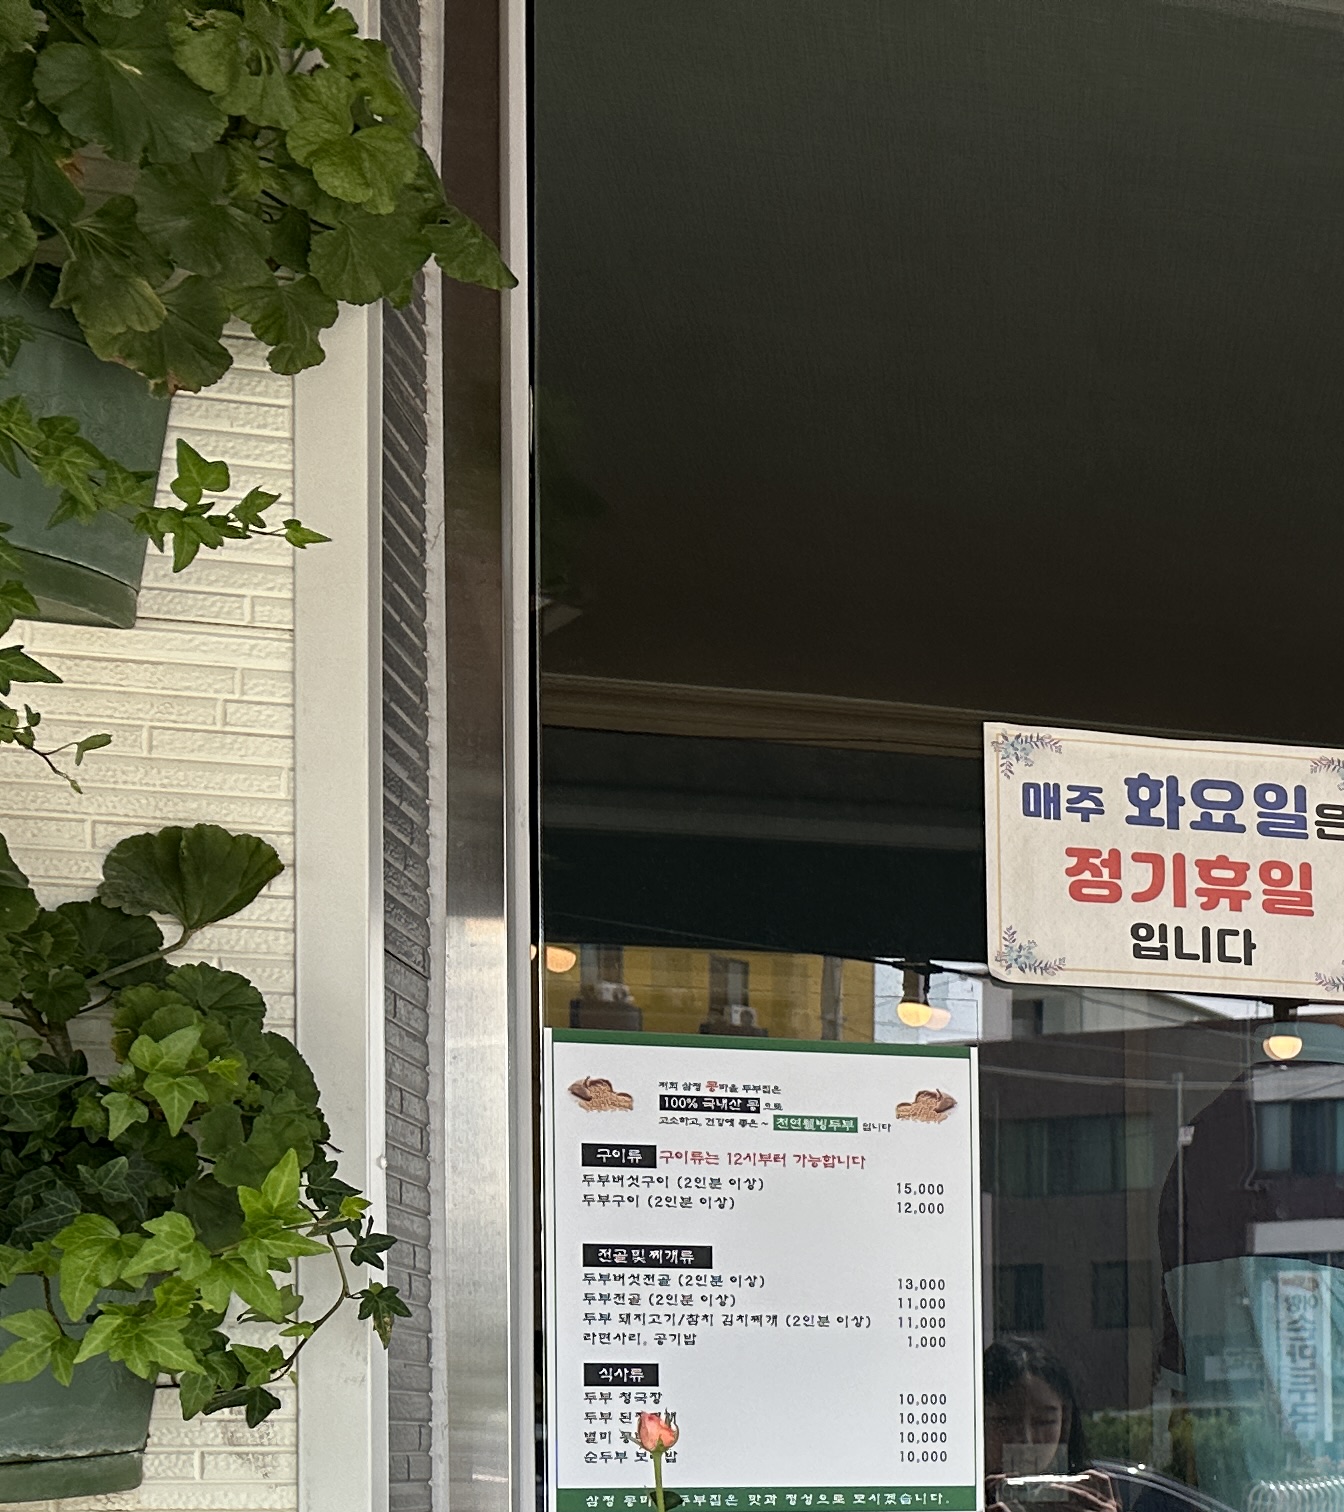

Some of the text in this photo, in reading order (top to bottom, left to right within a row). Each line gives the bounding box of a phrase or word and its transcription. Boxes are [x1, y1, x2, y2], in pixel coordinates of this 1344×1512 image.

[1021, 781, 1106, 823] 매주
[1064, 846, 1315, 918] 정기휴일
[1130, 922, 1257, 967] 입니다
[664, 1096, 698, 1109] 100%
[702, 1097, 742, 1111] 국내산
[862, 1122, 892, 1133] 입니다
[596, 1148, 867, 1170] 구이류 구이류는 12시부터 가능합니다
[582, 1173, 945, 1196] 두부버섯구이 (2인분 이상) 15,000
[582, 1193, 945, 1215] 두부구이 (2인분 이상) 12,000
[582, 1272, 946, 1291] 두부버섯전골 (2인분 이상) 13,000
[582, 1292, 946, 1311] 두부전골 (2인분 이상) 11,000
[582, 1312, 946, 1330] 두부 돼지고기/참치 김치찌개 (2인분 이상) 11,000
[653, 1332, 697, 1347] 공기밥
[907, 1335, 946, 1349] 1,000
[598, 1366, 645, 1382] 식사류
[583, 1391, 947, 1407] 두부 청국장 10,000
[583, 1411, 613, 1425] 두부
[899, 1412, 947, 1426] 10,000
[583, 1430, 612, 1445] 별미
[899, 1431, 948, 1445] 10,000
[583, 1450, 948, 1465] 순두부 보밥 10,000
[748, 1493, 778, 1507] 맛과
[785, 1493, 846, 1507] 정성으로
